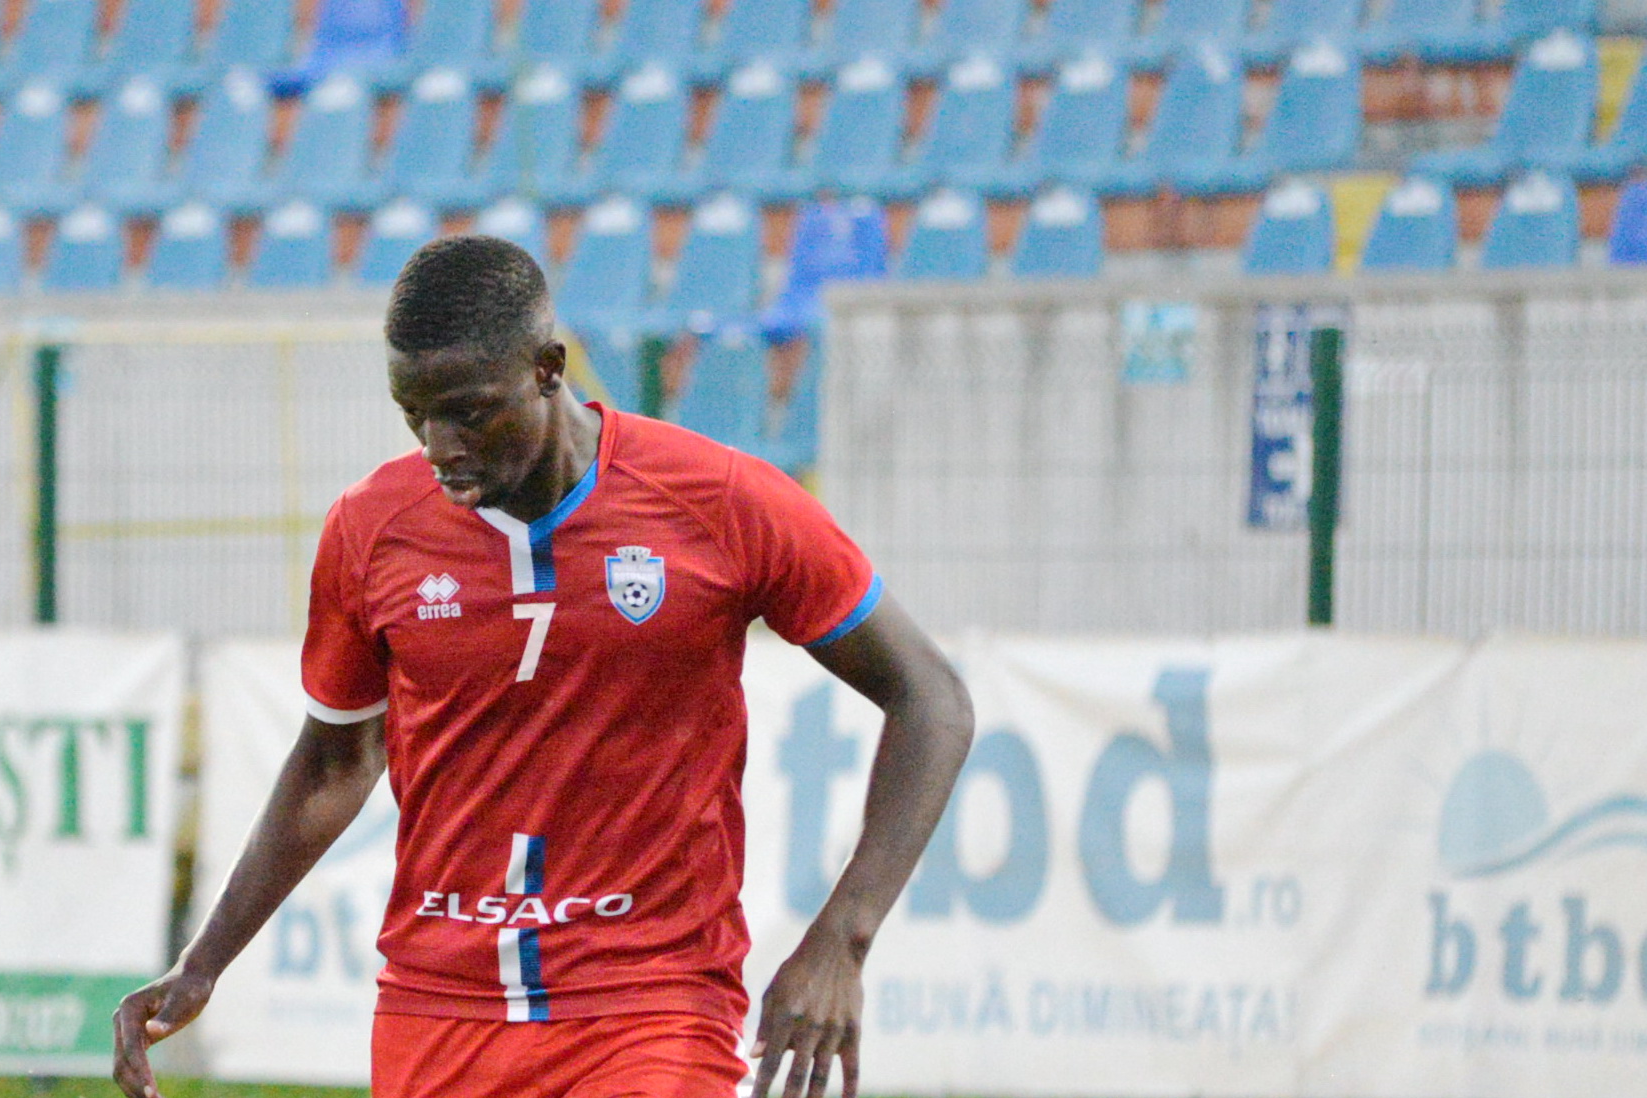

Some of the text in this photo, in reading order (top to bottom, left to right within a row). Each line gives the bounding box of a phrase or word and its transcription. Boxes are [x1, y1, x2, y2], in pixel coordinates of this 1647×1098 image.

[417, 602, 462, 620] errea
[513, 602, 556, 682] 7
[415, 890, 634, 925] ELSACO
